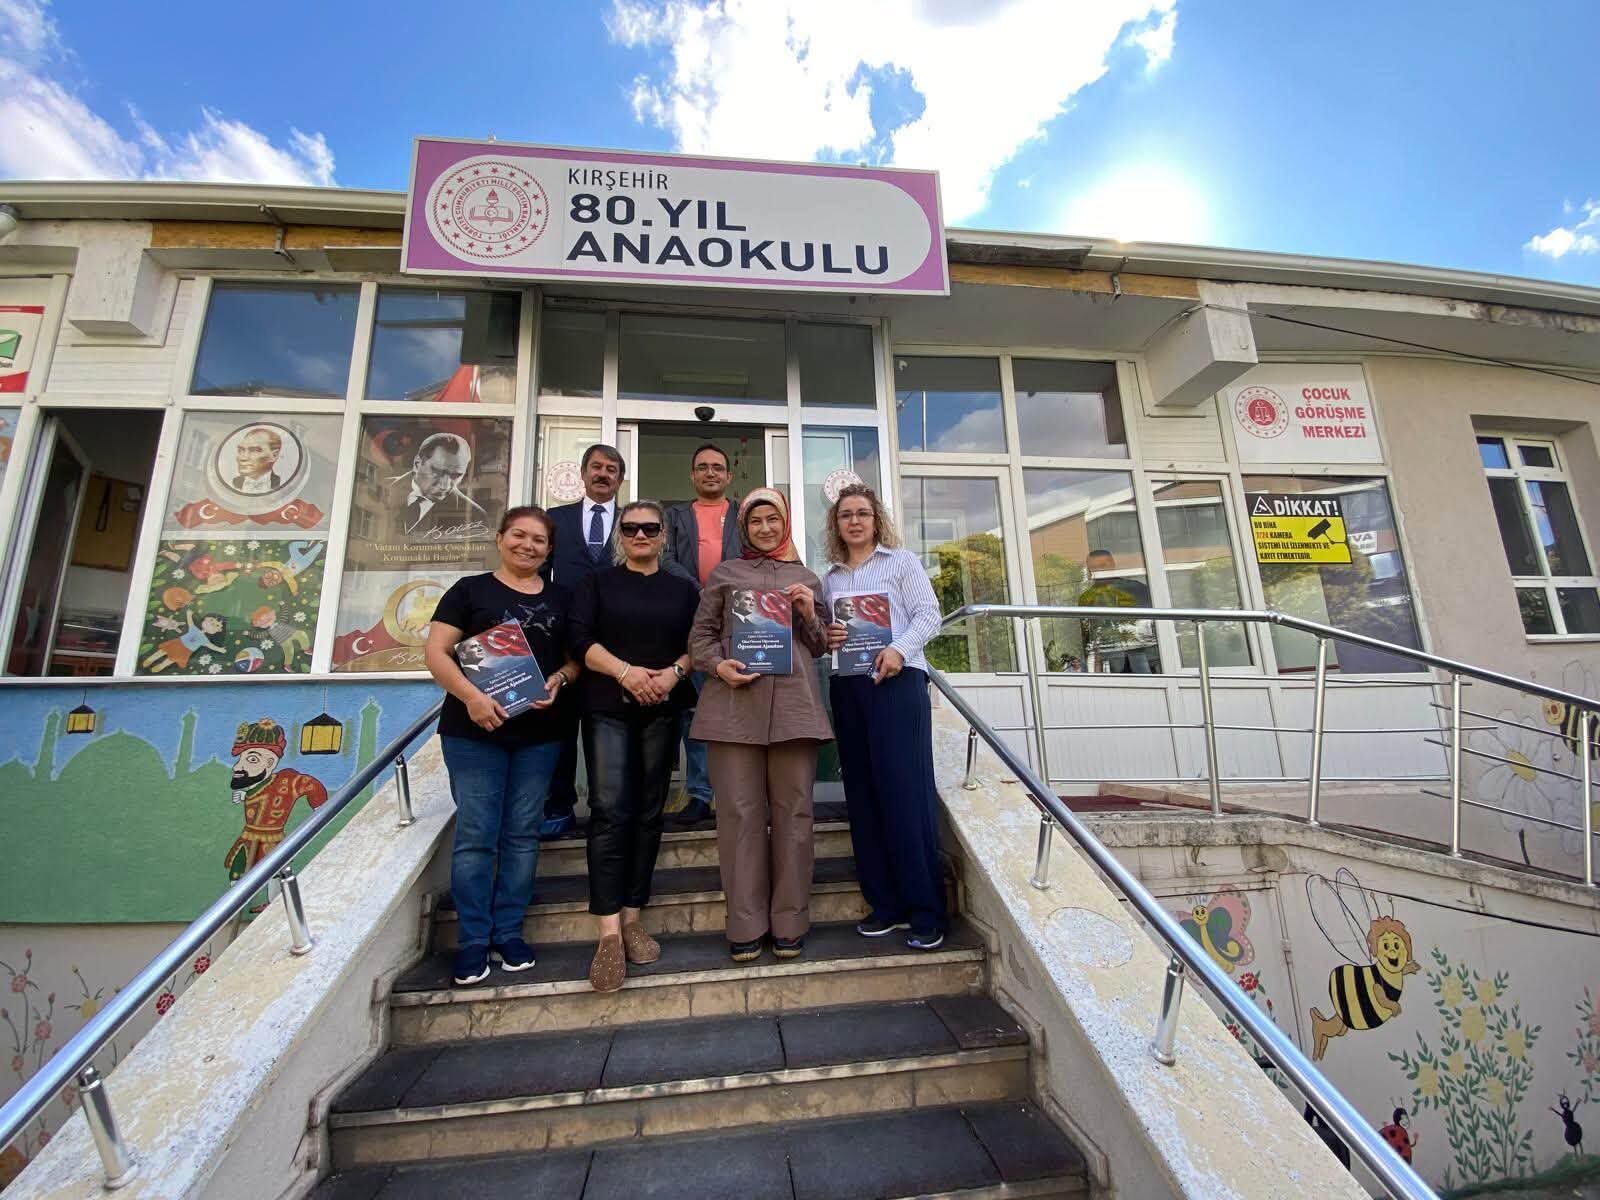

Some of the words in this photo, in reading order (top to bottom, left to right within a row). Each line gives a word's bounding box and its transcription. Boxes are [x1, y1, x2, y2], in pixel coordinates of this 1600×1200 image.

[568, 167, 669, 191] KIRŞEHİR
[569, 192, 747, 232] 80.YIL
[566, 231, 889, 275] ANAOKULU
[1302, 387, 1350, 402] ÇOCUK
[1295, 404, 1366, 422] GÖRÜŞME
[1302, 423, 1366, 438] MERKEZİ
[1274, 496, 1339, 516] DİKKAT!
